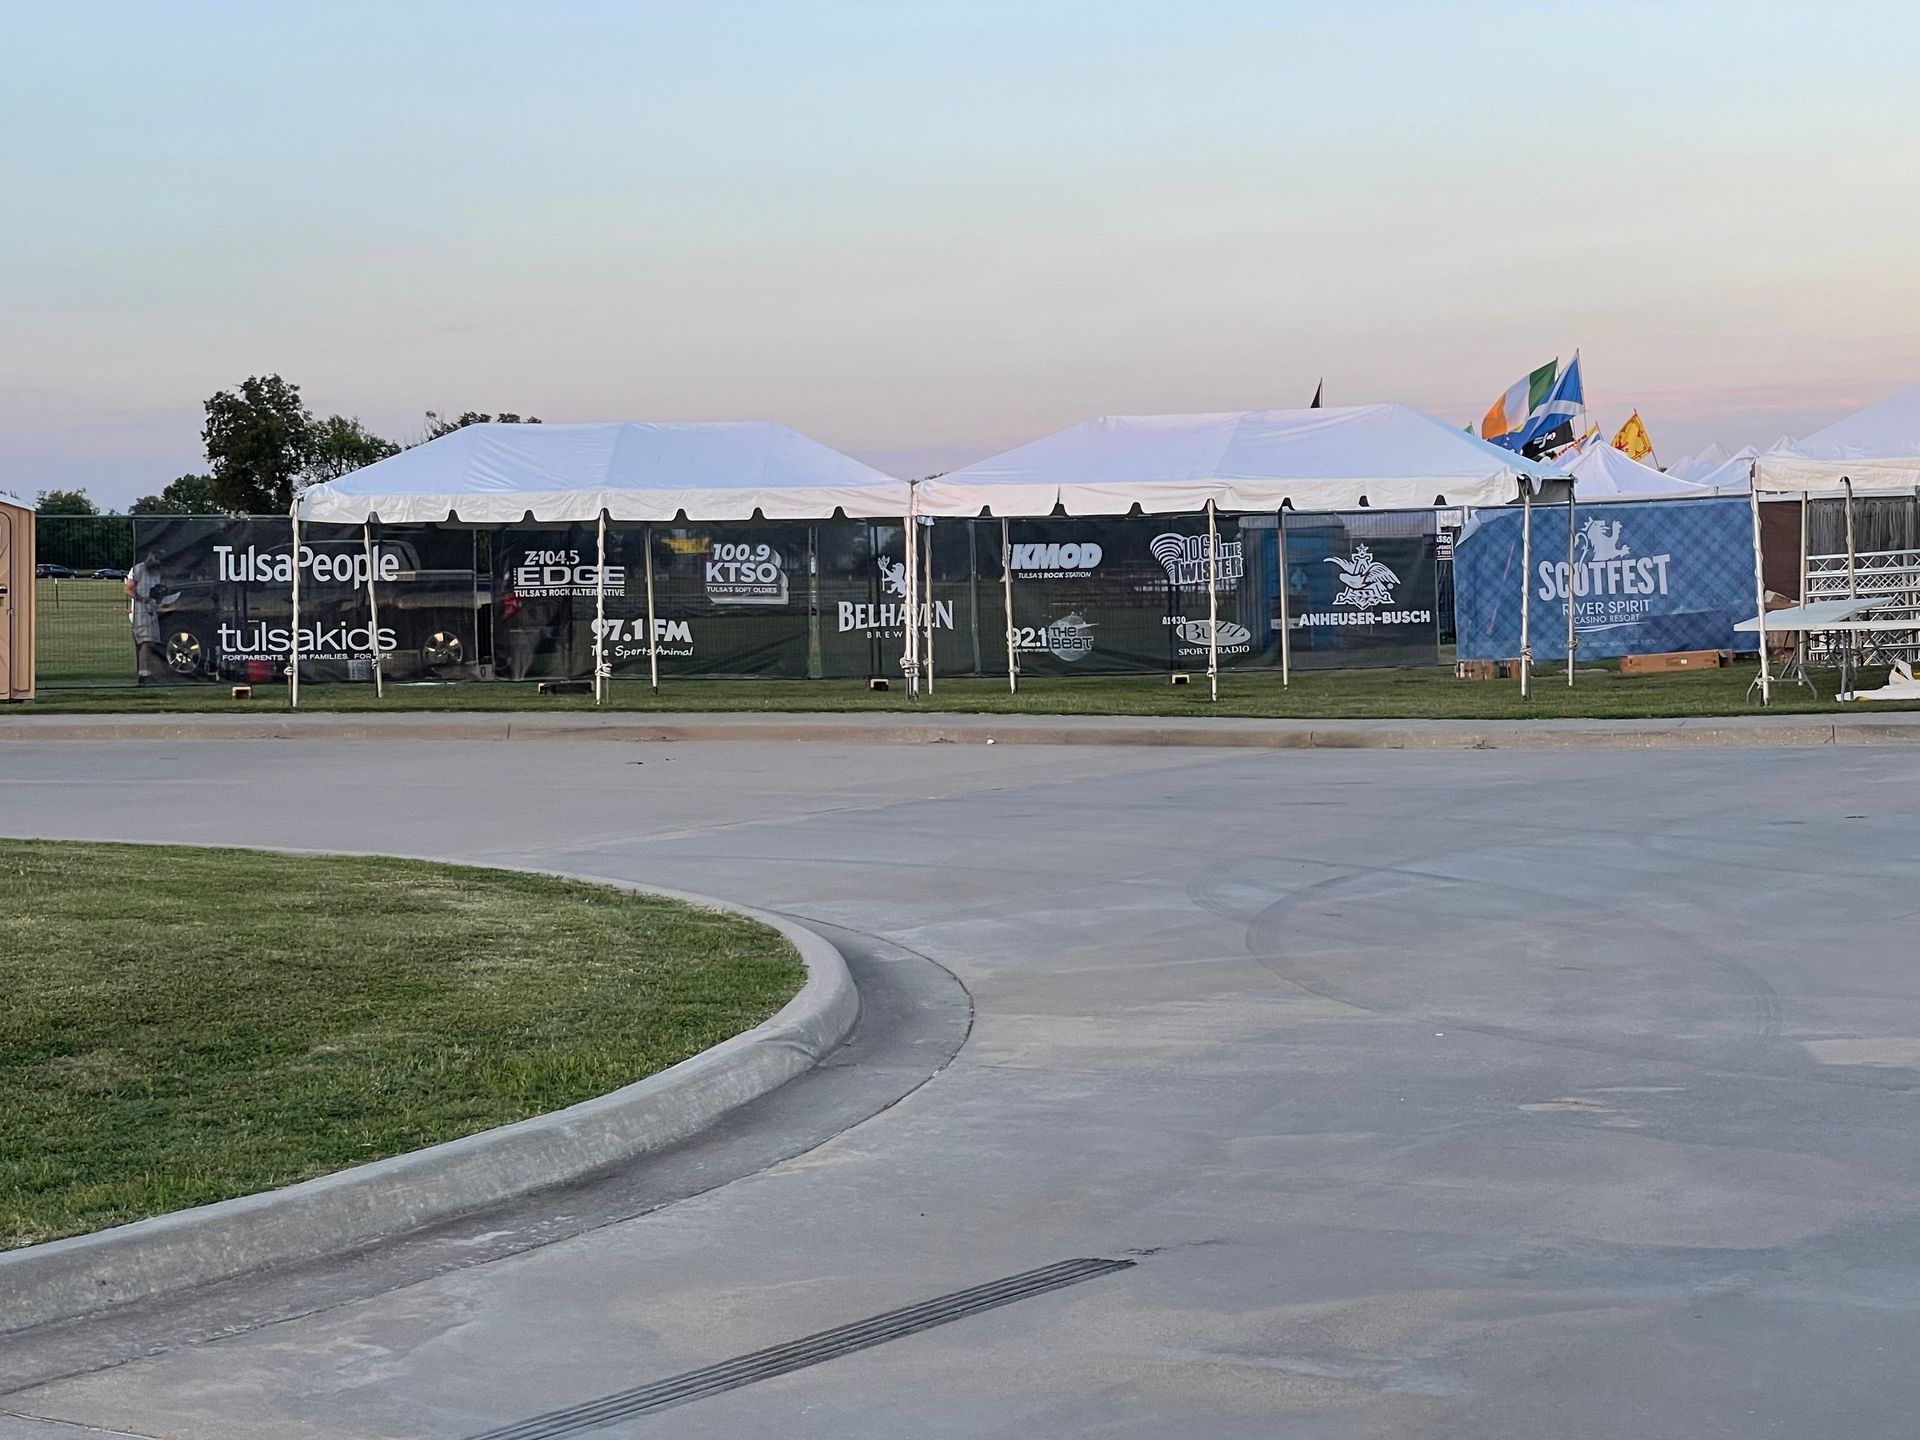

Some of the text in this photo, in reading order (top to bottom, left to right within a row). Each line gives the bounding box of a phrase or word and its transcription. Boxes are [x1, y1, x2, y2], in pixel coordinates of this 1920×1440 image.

[713, 544, 770, 561] 100.9
[1011, 542, 1103, 570] KMOD
[1221, 542, 1242, 558] THE
[213, 545, 399, 590] TulsaPeople
[517, 565, 625, 586] EDGE
[706, 562, 778, 583] KTSO
[1172, 556, 1243, 585] TWISTER
[1539, 554, 1670, 600] SCOTFEST
[514, 590, 547, 598] TULSA'S
[572, 588, 625, 597] ALTERATIVE
[1562, 600, 1650, 616] RIVER SPIRIT
[1300, 611, 1431, 626] ANHEUSER-BUSCH
[1574, 613, 1640, 625] CASINO RESORT
[217, 621, 397, 652] tulsakids
[591, 618, 693, 643] 97.1 FM
[866, 630, 930, 639] BREWY
[1006, 627, 1048, 647] 92.1
[591, 645, 694, 659] Te Sports Animal
[1178, 645, 1250, 656] SPORT RADIO
